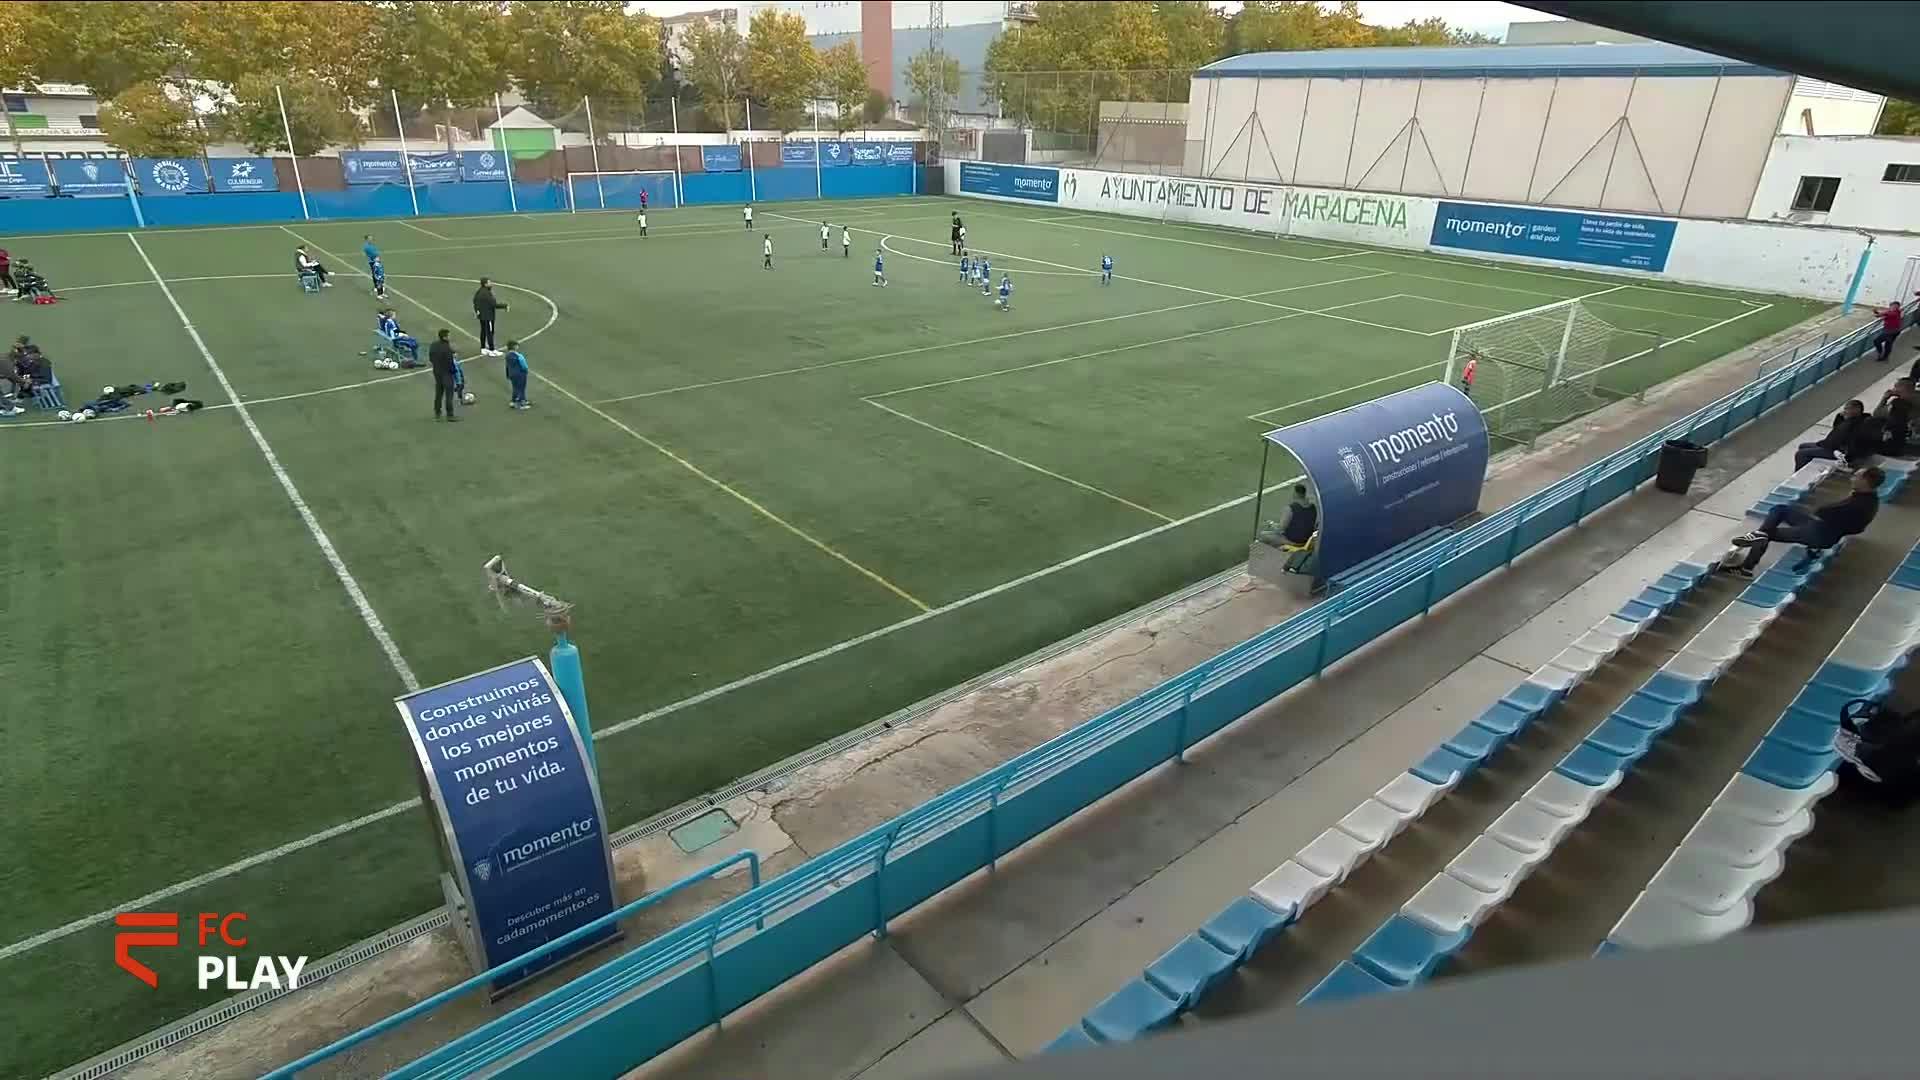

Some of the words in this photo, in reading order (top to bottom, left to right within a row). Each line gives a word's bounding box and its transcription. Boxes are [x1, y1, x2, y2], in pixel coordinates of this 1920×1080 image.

[1014, 176, 1053, 191] momento
[1101, 177, 1234, 211] AYUNTAMIENTO
[1244, 189, 1271, 215] DE
[1282, 191, 1407, 230] MARACENA
[1446, 215, 1526, 239] momento
[1530, 233, 1543, 242] and
[1544, 234, 1560, 243] pool
[1532, 224, 1557, 234] garden
[1368, 408, 1459, 463] momento
[419, 677, 540, 722] Construimos
[425, 714, 488, 741] donde
[491, 692, 552, 720] vivirás
[440, 741, 472, 760] los
[476, 713, 553, 749] mejores
[453, 735, 559, 783] momentos
[465, 787, 490, 806] de
[495, 775, 518, 794] tu
[521, 760, 566, 785] vida.
[503, 817, 593, 864] momento
[496, 892, 600, 945] cadamomento.es
[507, 903, 551, 927] Descubre
[553, 893, 573, 906] más
[574, 887, 587, 897] en
